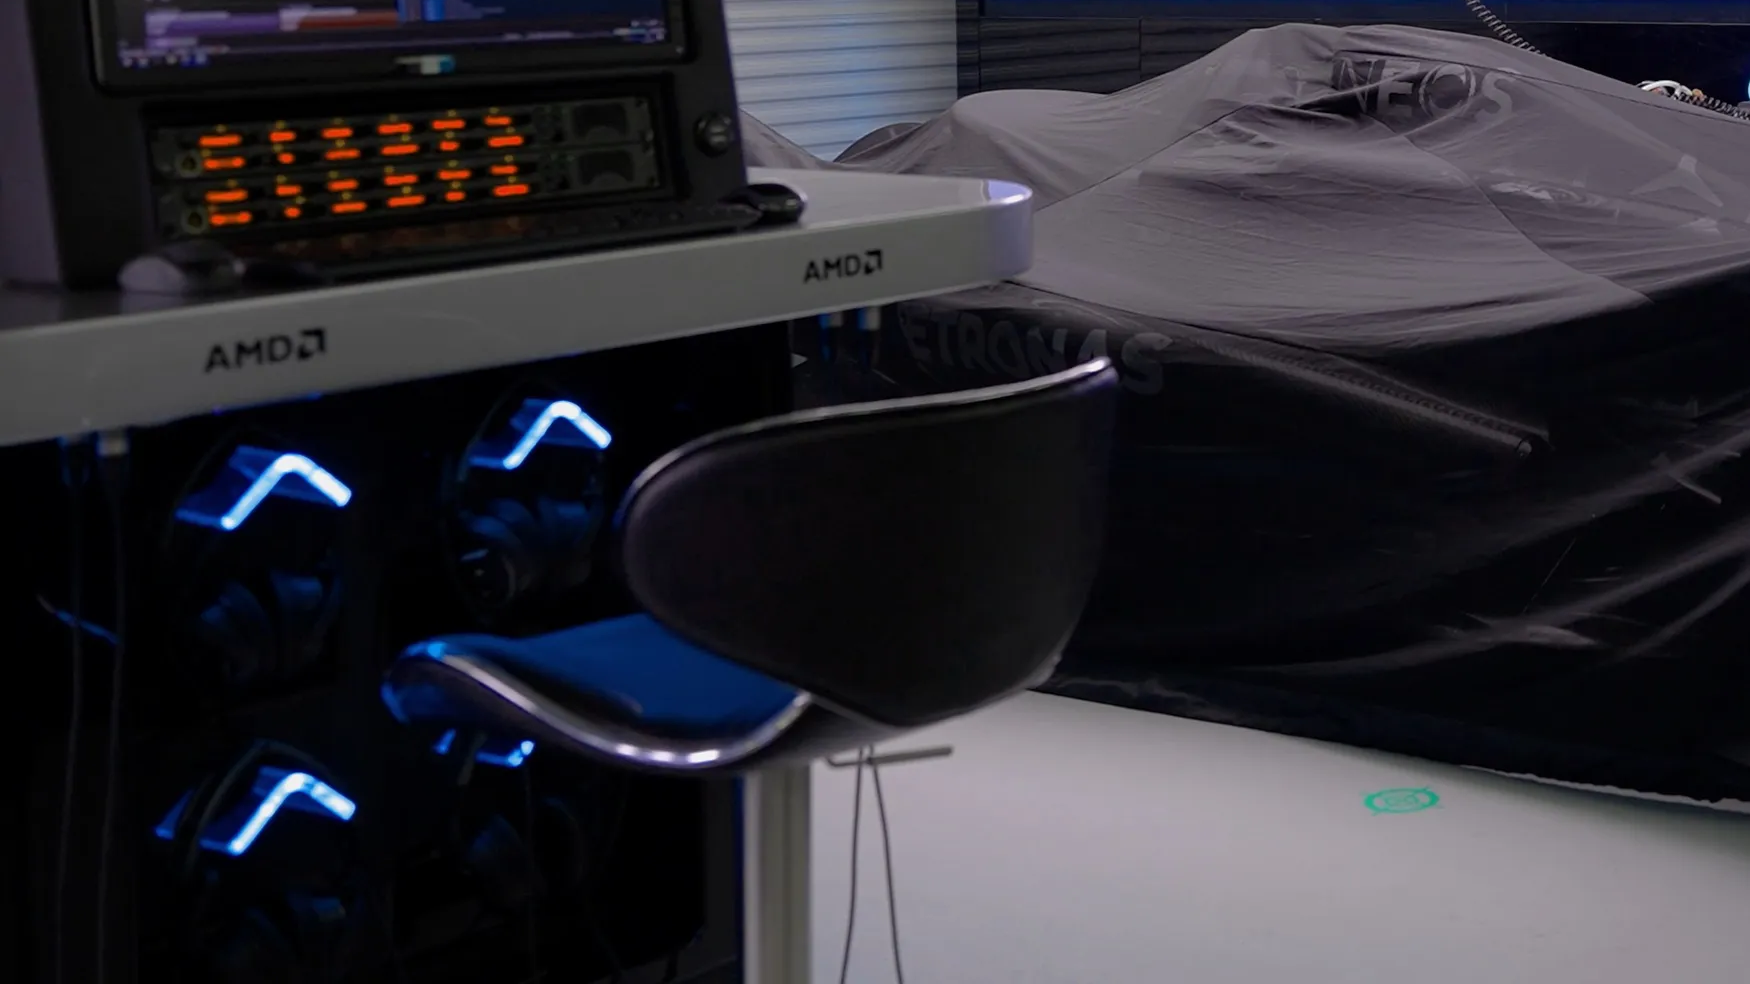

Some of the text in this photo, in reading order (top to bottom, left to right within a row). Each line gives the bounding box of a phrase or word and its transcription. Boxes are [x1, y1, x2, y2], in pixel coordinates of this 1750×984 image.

[1333, 58, 1516, 117] NEOS
[803, 254, 862, 285] AMD
[204, 334, 294, 374] AMD
[898, 307, 1174, 395] ETRONAS
